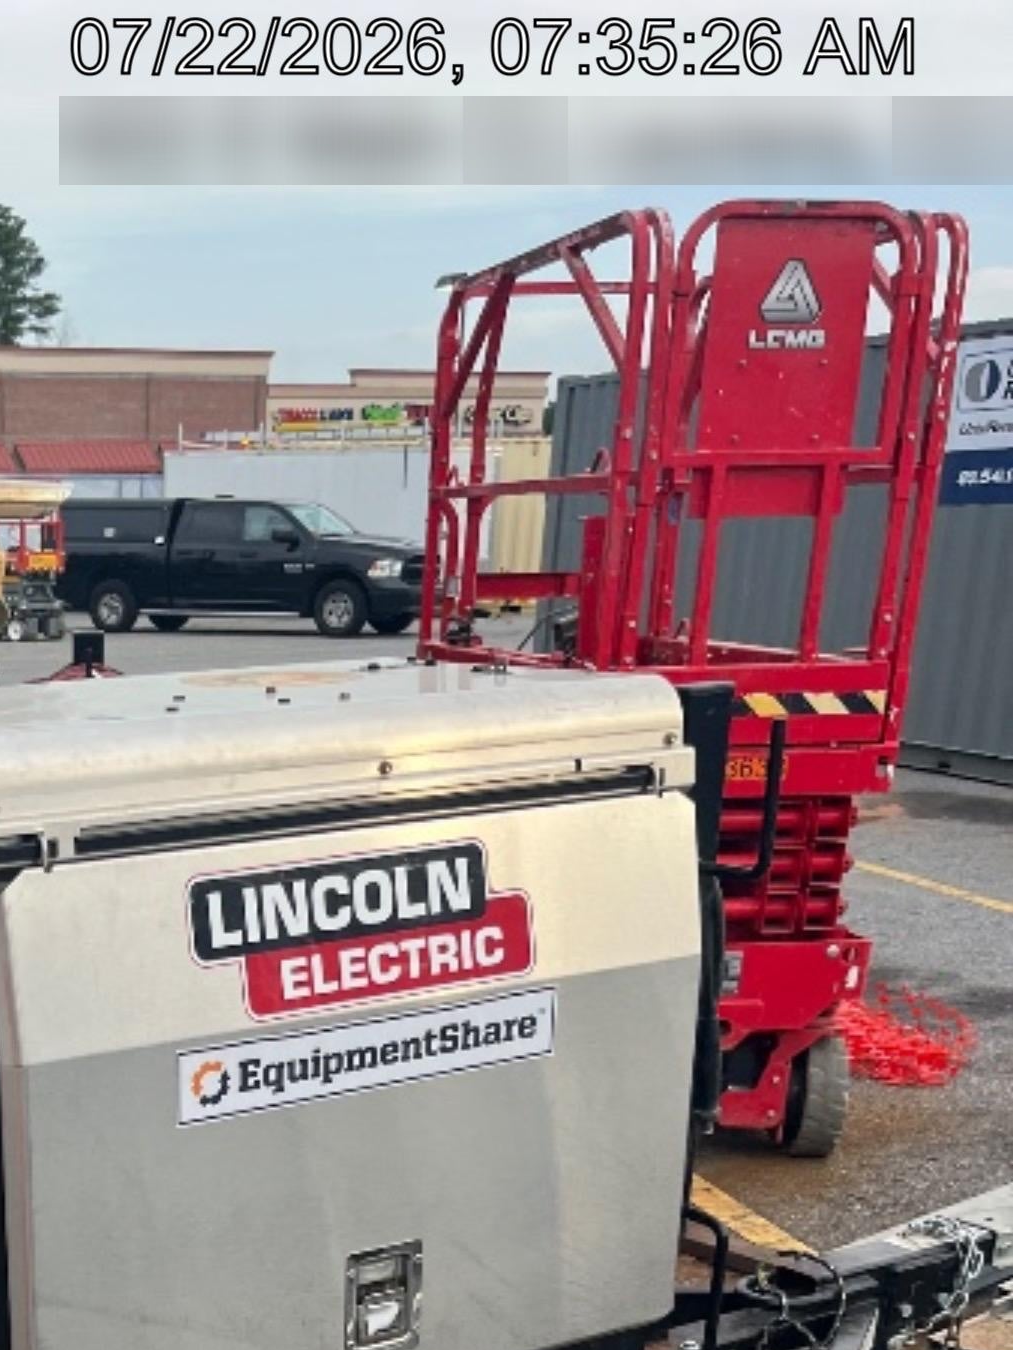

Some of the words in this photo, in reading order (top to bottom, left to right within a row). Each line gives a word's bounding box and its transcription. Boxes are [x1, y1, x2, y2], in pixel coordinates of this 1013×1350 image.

[205, 856, 472, 950] LINCOLN
[279, 926, 506, 1000] ELECTRIC
[238, 1011, 538, 1094] EquipmentShare
